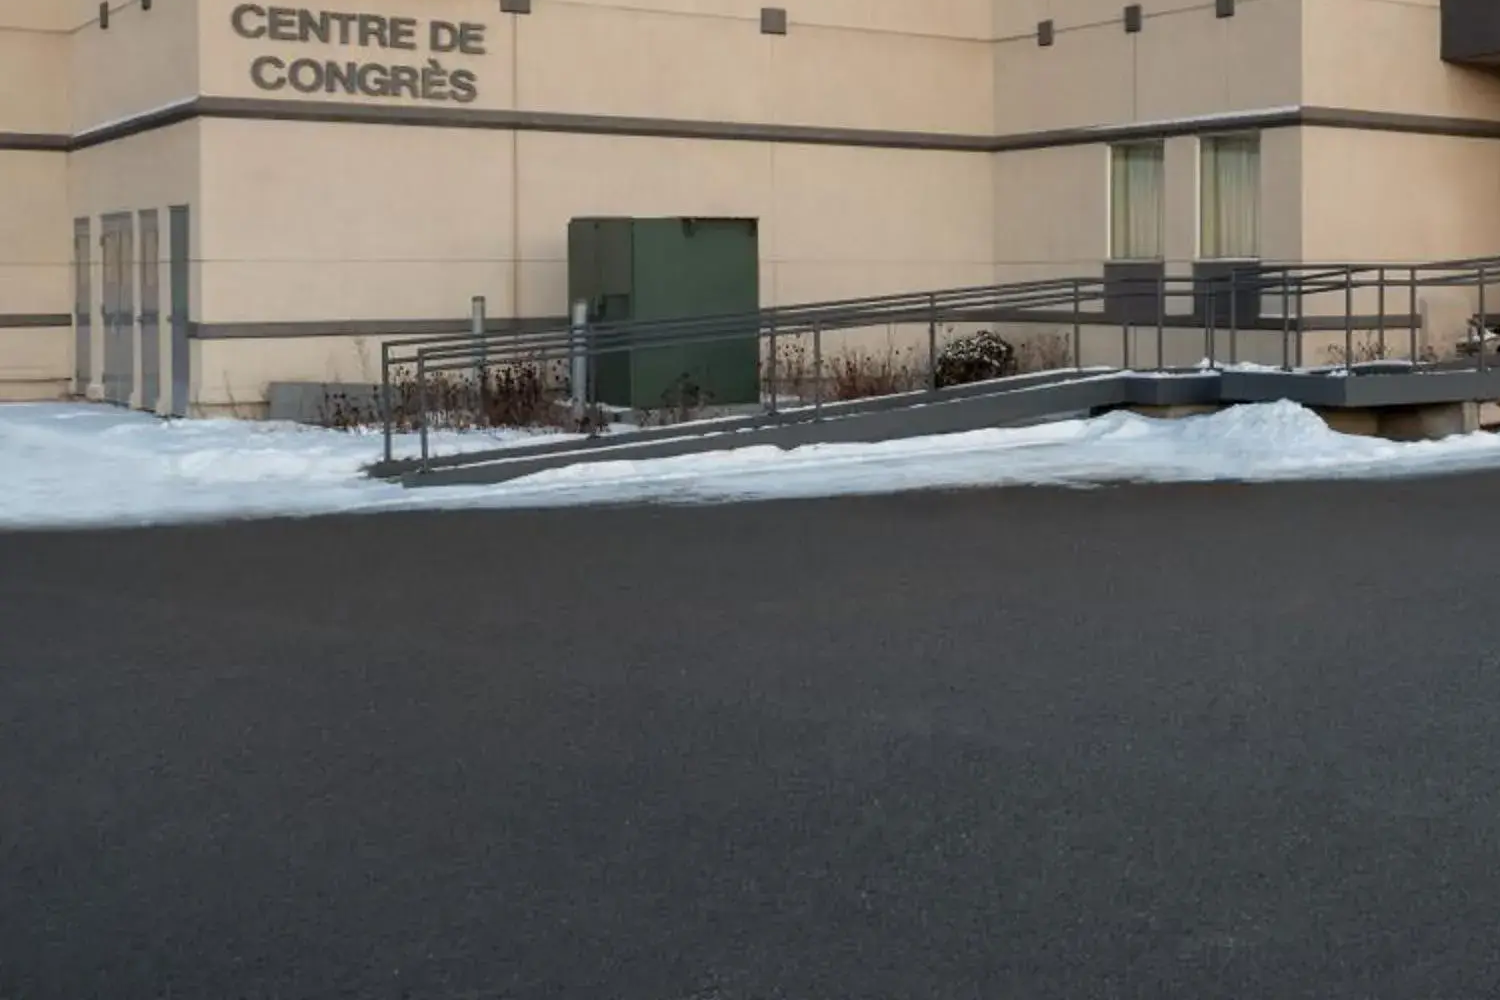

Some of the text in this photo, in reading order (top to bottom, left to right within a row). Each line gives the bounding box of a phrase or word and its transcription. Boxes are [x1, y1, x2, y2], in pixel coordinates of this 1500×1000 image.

[231, 3, 487, 55] CENTRE DE
[250, 56, 478, 103] CONGRÈS
